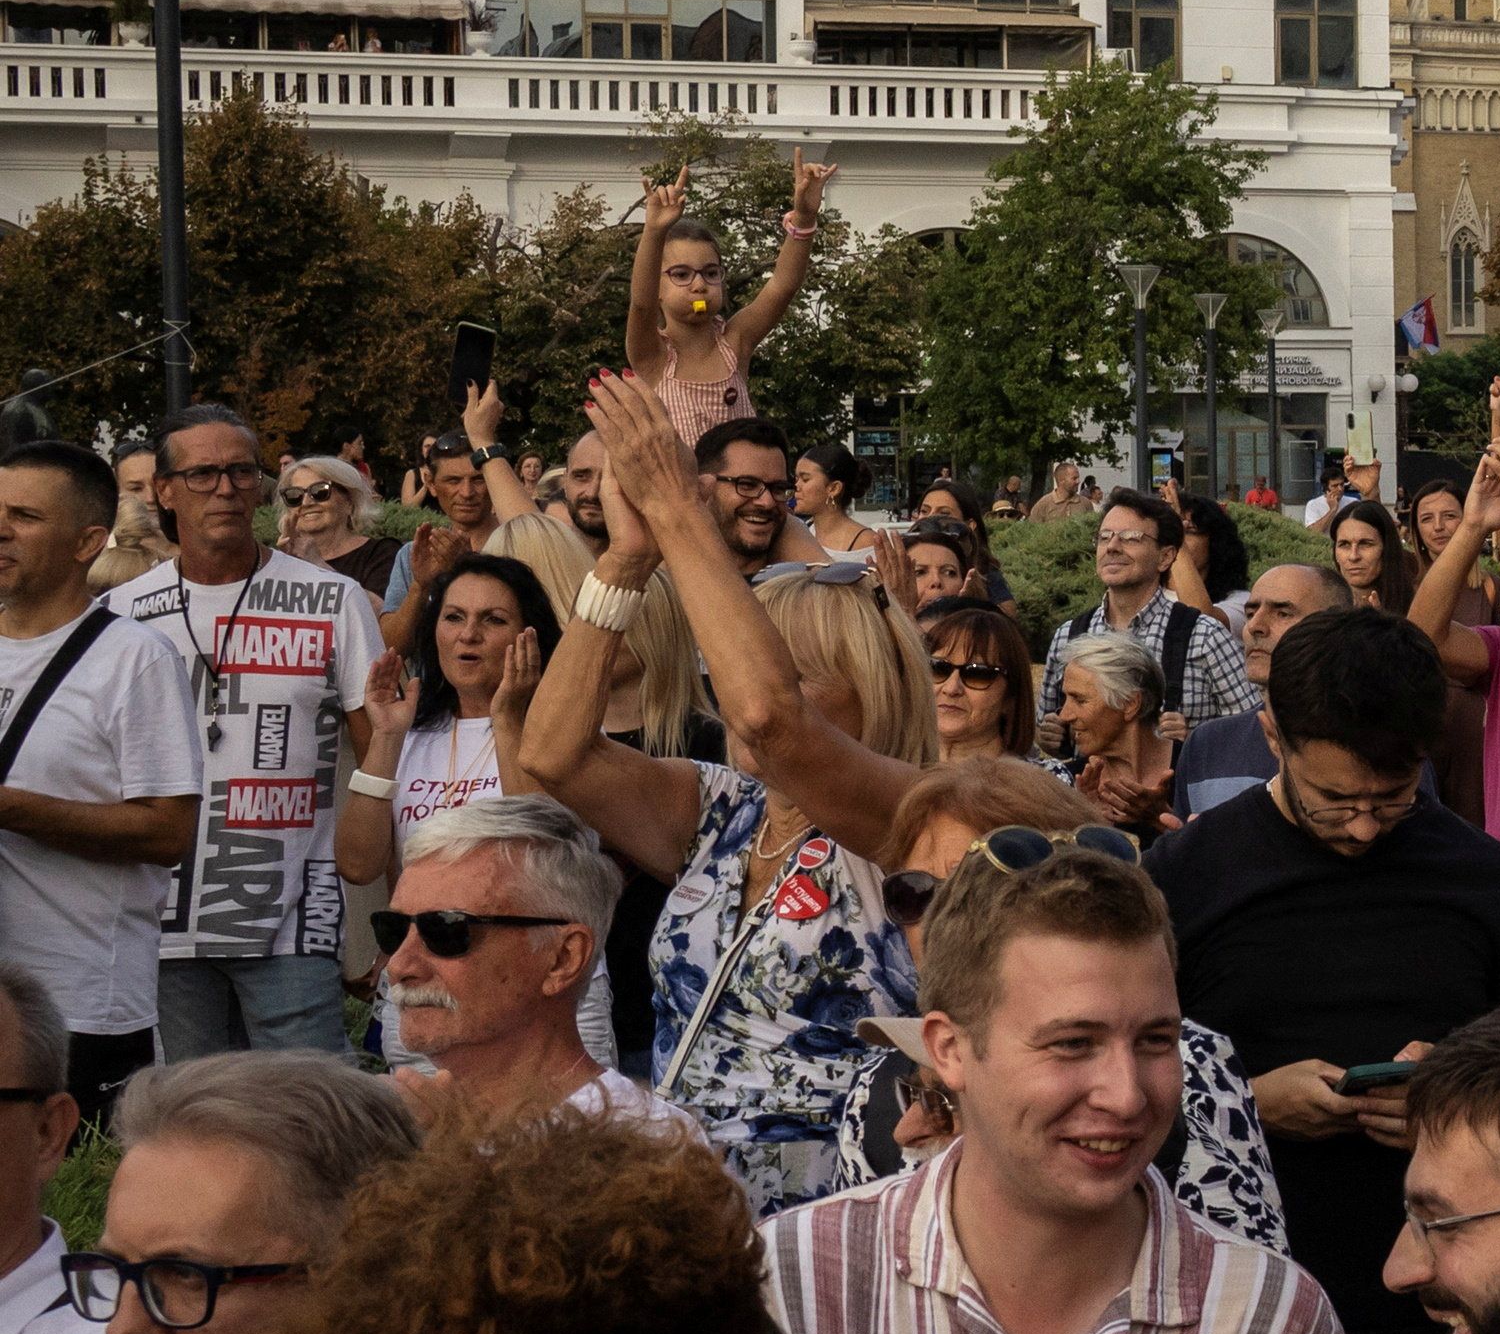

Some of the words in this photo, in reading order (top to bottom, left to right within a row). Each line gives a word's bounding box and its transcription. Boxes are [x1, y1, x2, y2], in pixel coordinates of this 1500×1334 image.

[131, 589, 189, 618] MARVE
[217, 624, 326, 668] MARVEL
[258, 706, 288, 770] MARVEL
[227, 784, 315, 821] MARVEL
[408, 776, 498, 797] СТУДЕН
[303, 861, 341, 955] MARVEL
